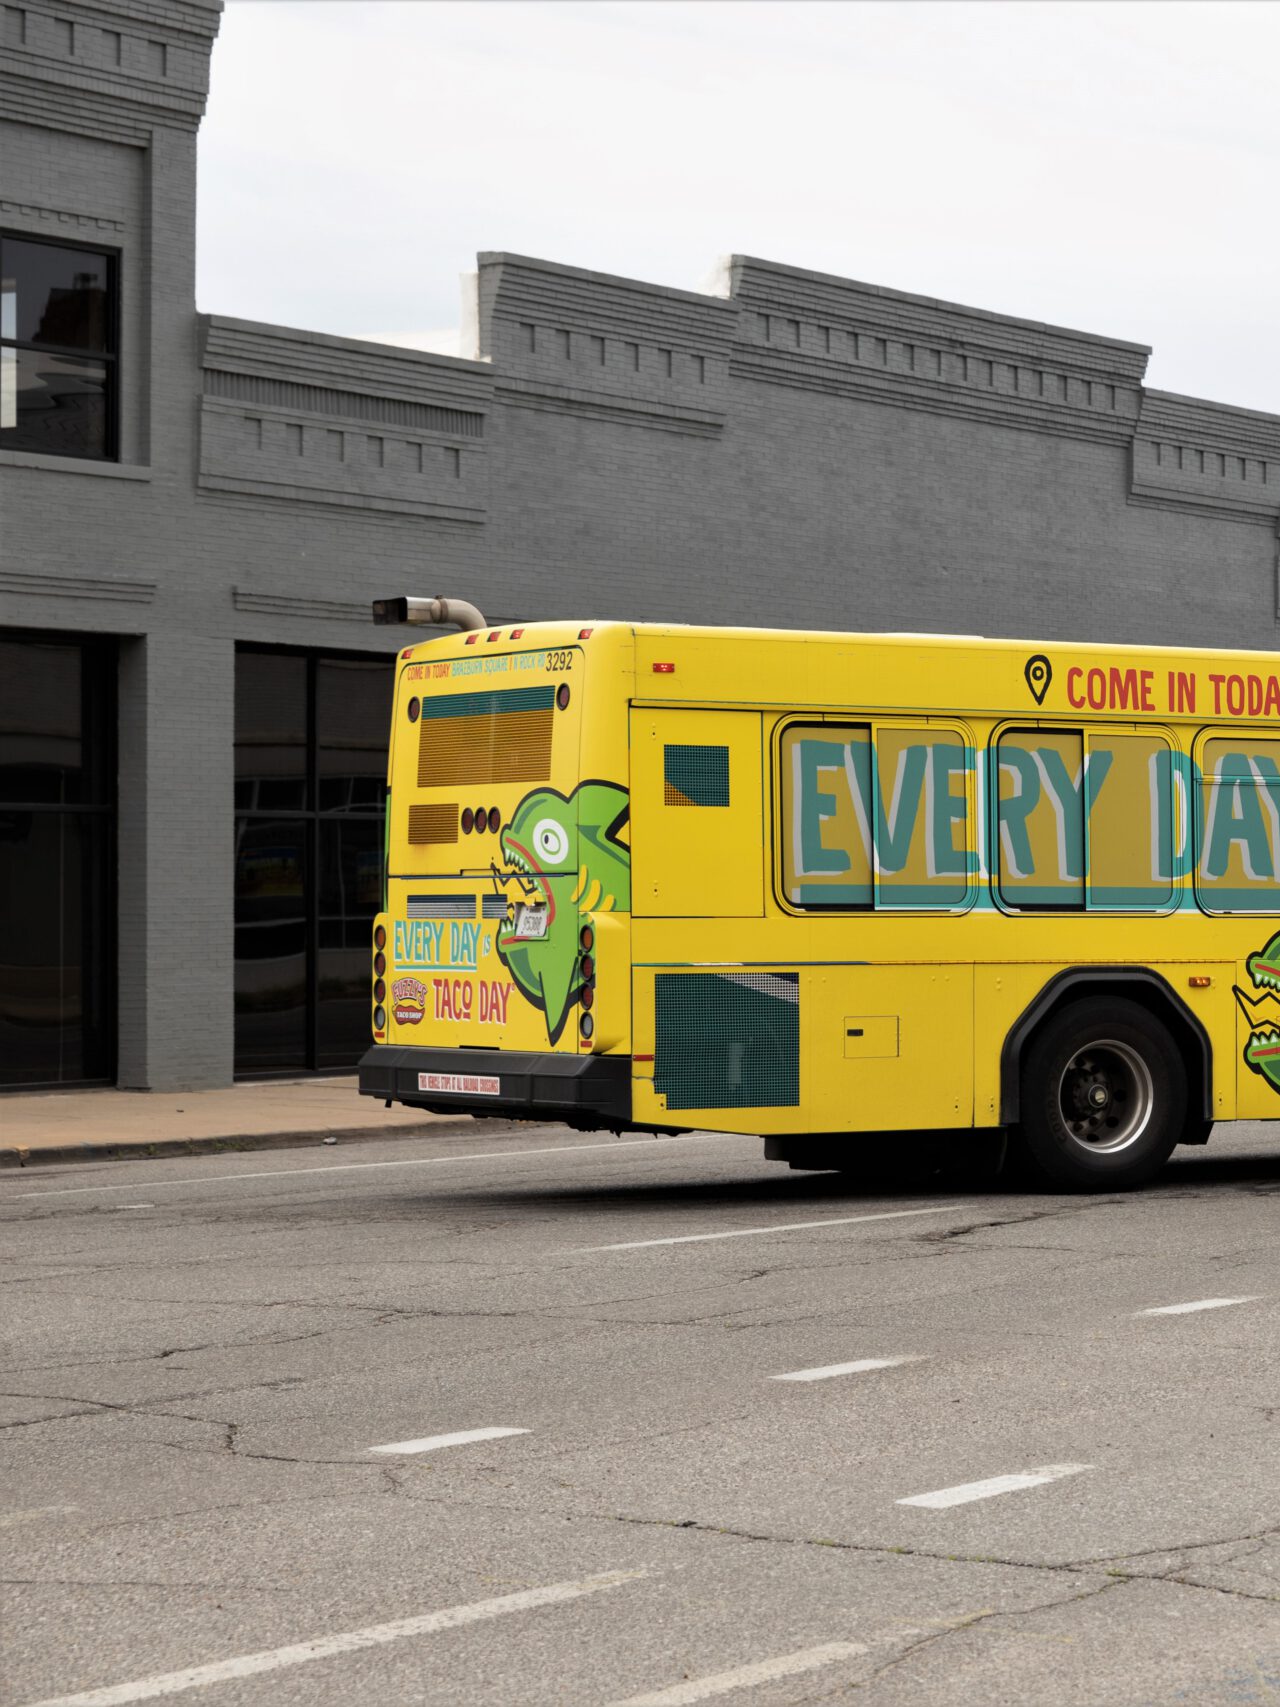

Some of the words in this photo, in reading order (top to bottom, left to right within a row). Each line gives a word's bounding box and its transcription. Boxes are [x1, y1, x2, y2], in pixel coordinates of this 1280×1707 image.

[407, 666, 423, 681] COME
[424, 665, 431, 680] IN
[432, 663, 451, 680] TODAY
[451, 659, 483, 677] BRAEBURN
[485, 657, 508, 676] SQUARE
[520, 654, 536, 671] ROCK
[545, 651, 573, 672] 3292
[1067, 666, 1156, 712] COME
[1168, 671, 1196, 714] IN
[792, 739, 1113, 881] EVERY
[394, 920, 444, 964] EVERY
[450, 922, 482, 966] DAY
[482, 934, 491, 957] IS
[391, 977, 428, 1006] FUZZY'S
[433, 978, 473, 1022] TACO
